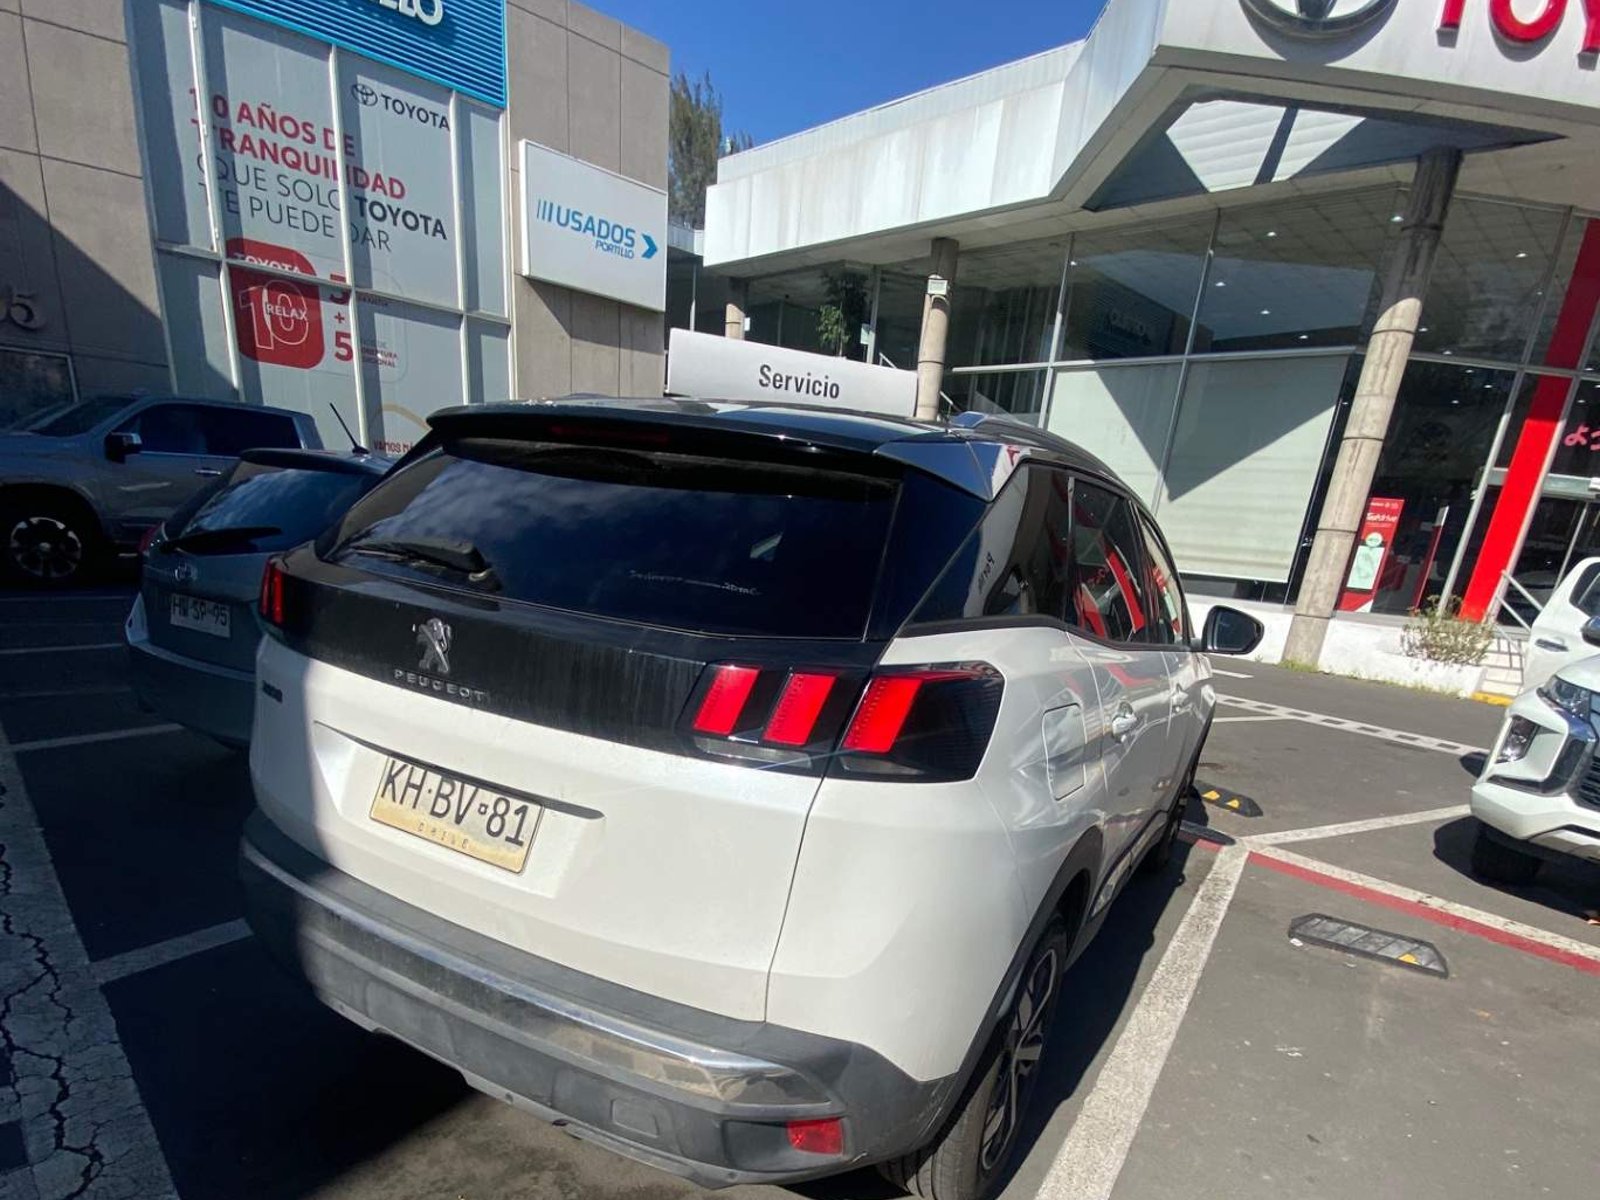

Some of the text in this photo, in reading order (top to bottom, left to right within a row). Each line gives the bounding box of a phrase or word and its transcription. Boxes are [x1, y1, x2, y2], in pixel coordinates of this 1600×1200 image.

[236, 101, 316, 144] AÑOS
[381, 94, 451, 132] TOYOTA
[249, 196, 335, 238] PUEDE
[354, 194, 448, 240] TOYOTA
[556, 205, 636, 248] USADOS
[595, 240, 635, 260] PORTILLO
[265, 302, 308, 322] RELAX
[334, 331, 354, 362] 5
[759, 364, 840, 399] Servicio
[394, 668, 486, 702] PEUGEOT
